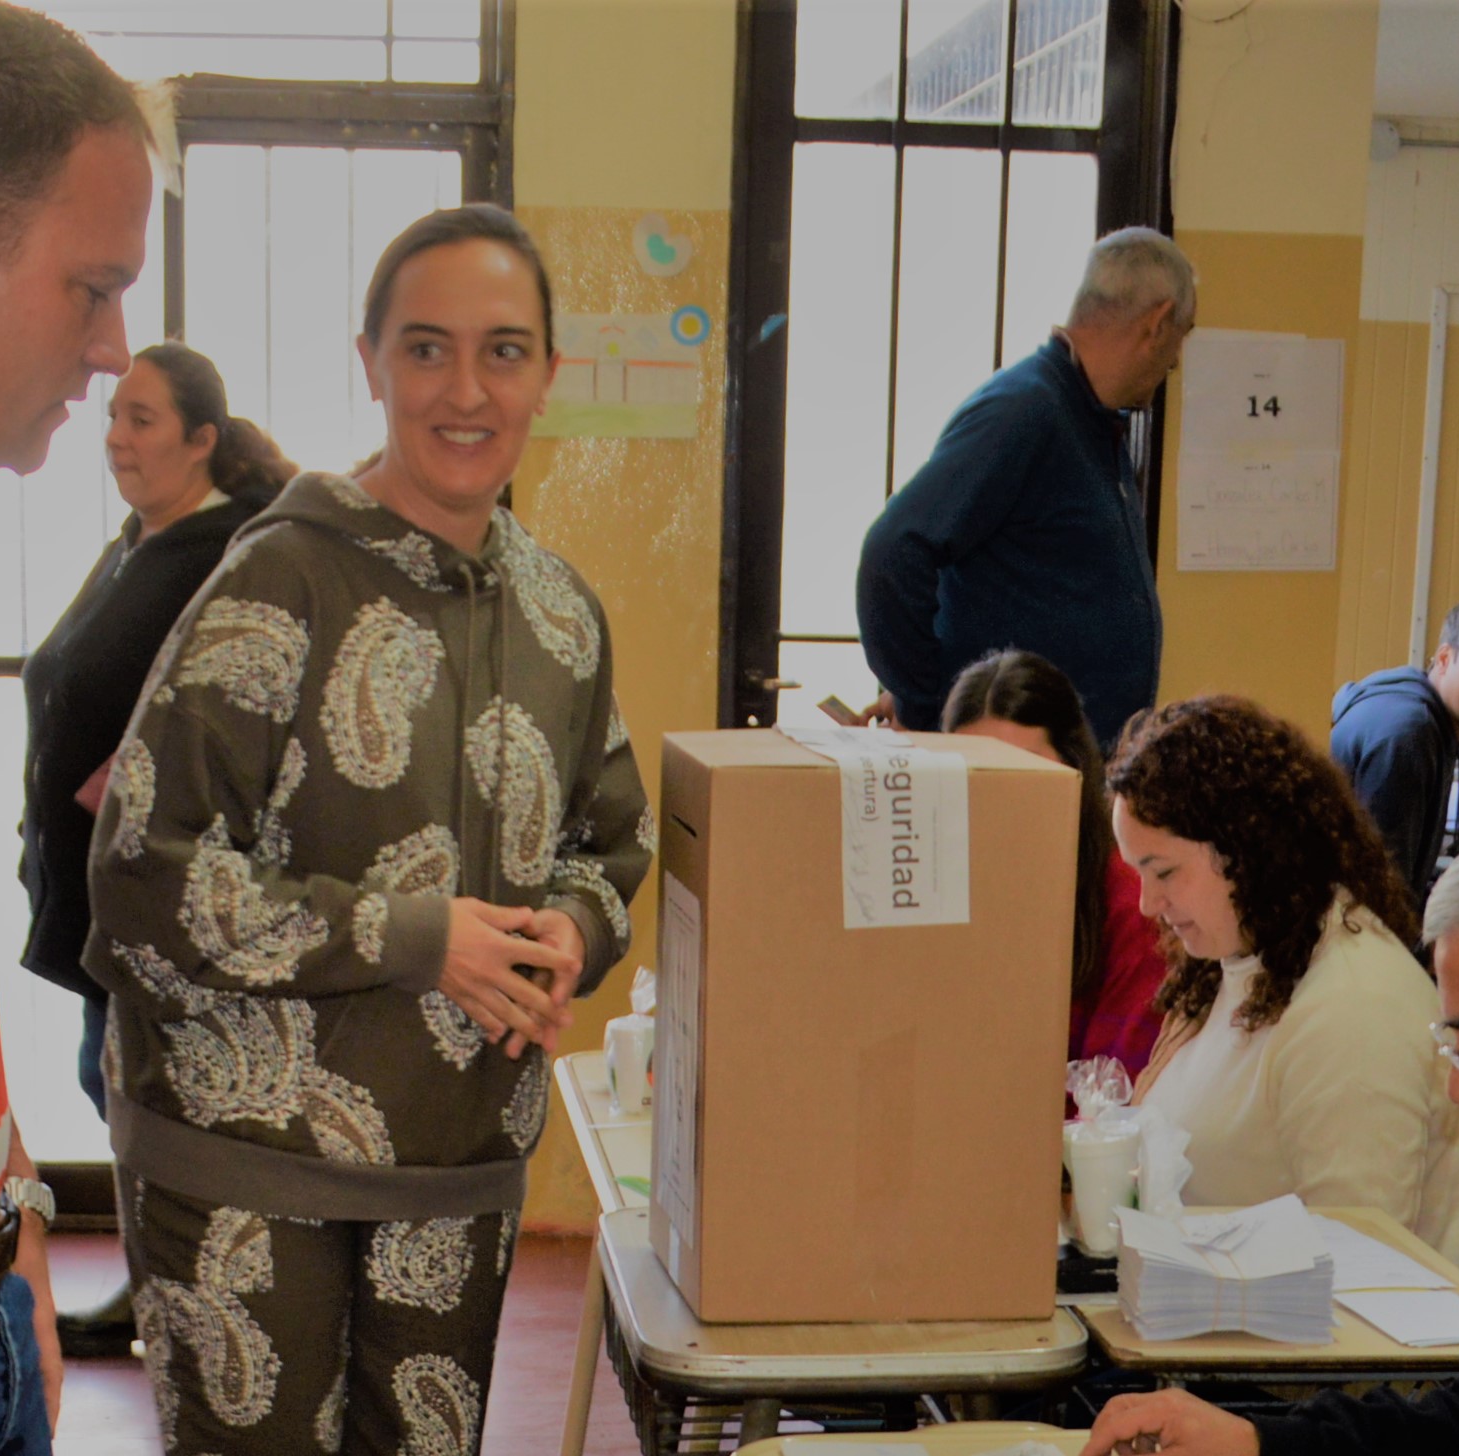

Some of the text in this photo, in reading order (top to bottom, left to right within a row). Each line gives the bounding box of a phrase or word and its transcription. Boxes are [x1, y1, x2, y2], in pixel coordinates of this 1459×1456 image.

[1246, 395, 1282, 418] 14
[861, 757, 880, 823] ertura)
[883, 753, 920, 909] eguridad
